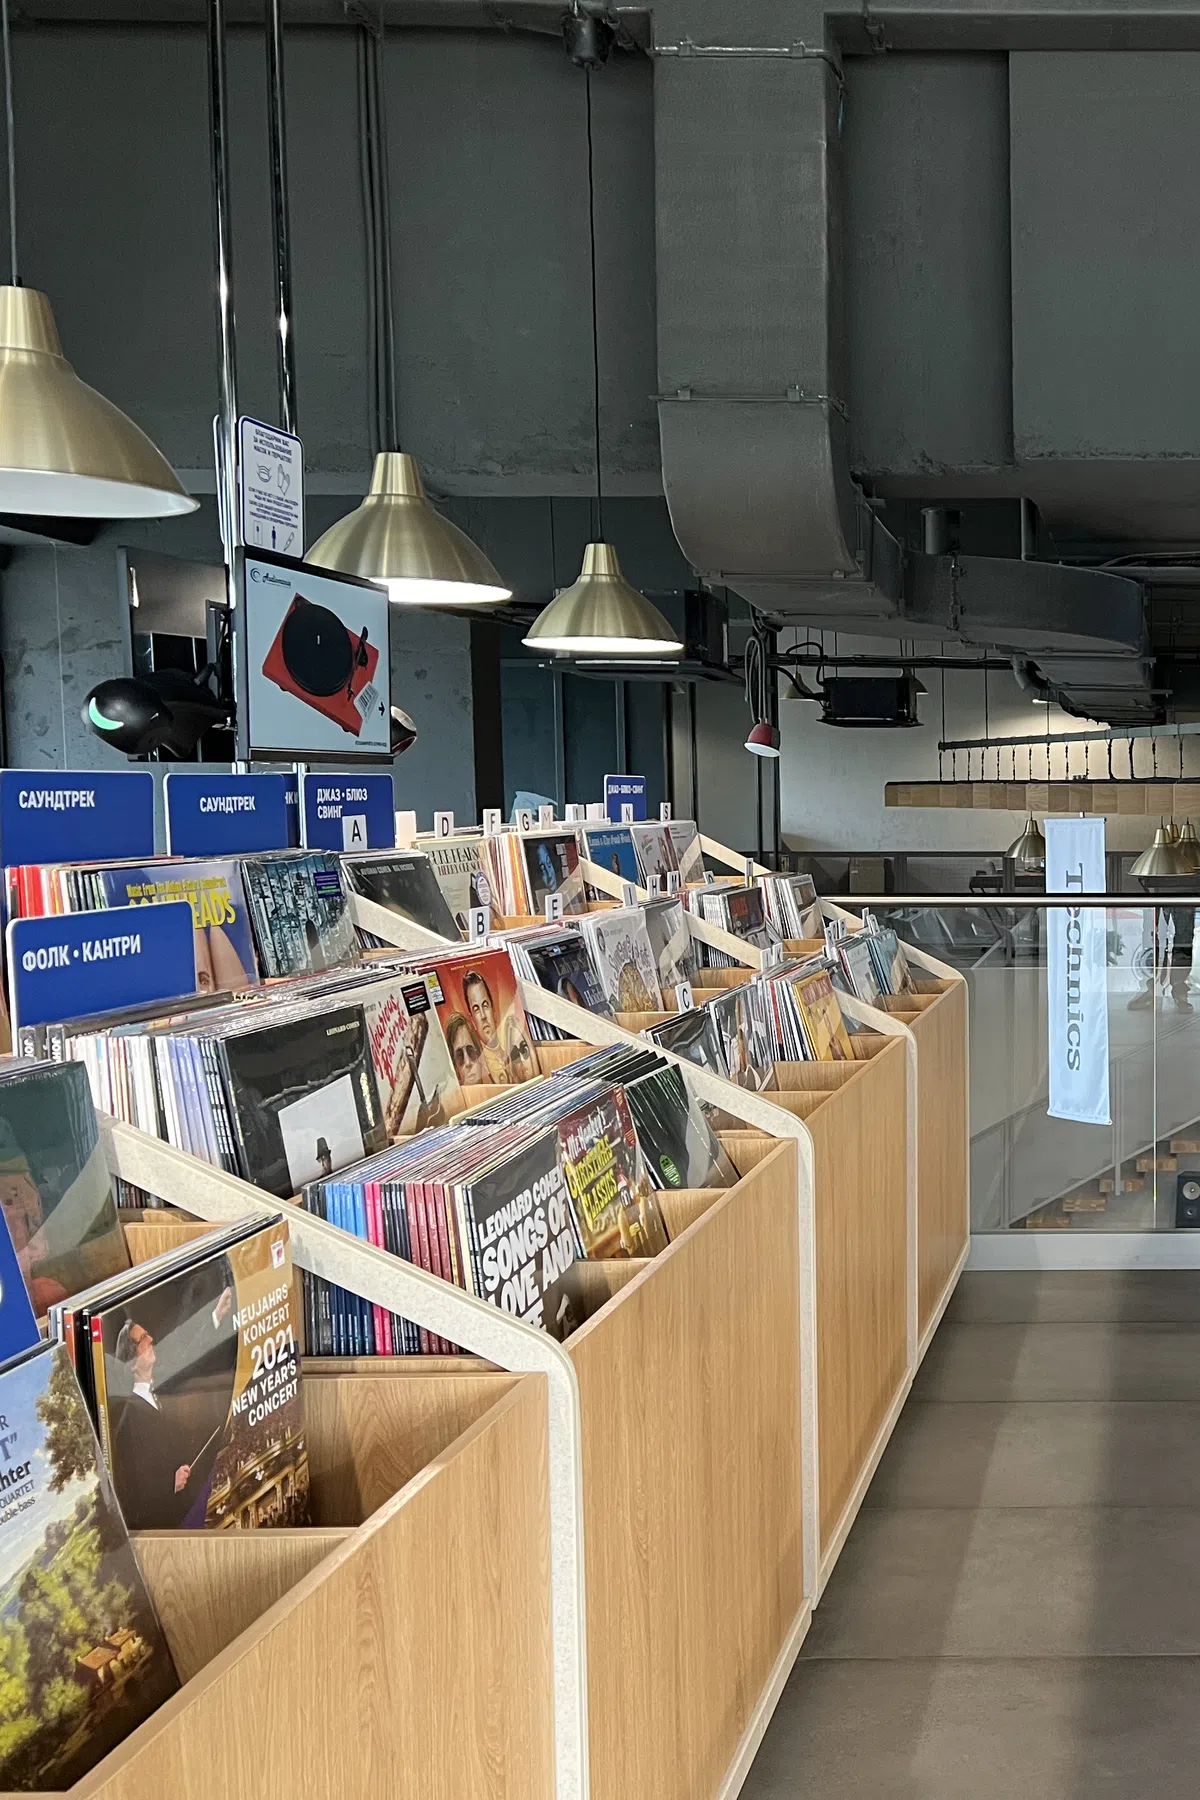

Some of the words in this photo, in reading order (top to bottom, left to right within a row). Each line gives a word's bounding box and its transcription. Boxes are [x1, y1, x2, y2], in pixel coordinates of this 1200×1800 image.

[18, 790, 95, 811] САУНДТРЕК
[199, 796, 256, 814] САУНДТРЕК
[316, 788, 341, 804] ДЖАЗ
[346, 788, 368, 801] БЛЮЗ
[317, 805, 343, 819] СВИНГ
[490, 813, 496, 832] F
[522, 813, 530, 831] G
[351, 820, 362, 843] A
[441, 817, 449, 836] D
[552, 901, 558, 920] E
[476, 915, 485, 935] B
[22, 945, 71, 971] ФОЛК
[82, 934, 141, 962] КАНТРИ
[681, 988, 690, 1010] C
[478, 1189, 532, 1250] LEONARD
[532, 1162, 565, 1206] COHEN
[483, 1207, 548, 1292] SONGS
[548, 1187, 567, 1236] OF
[488, 1259, 540, 1317] OVE
[542, 1228, 575, 1292] AND
[232, 1284, 288, 1331] NEUJAHRS
[243, 1303, 290, 1347] KONZERT
[250, 1323, 295, 1380] 2021
[232, 1389, 258, 1417] NEW
[259, 1359, 297, 1401] YEAR'S
[248, 1378, 298, 1427] CONCERT
